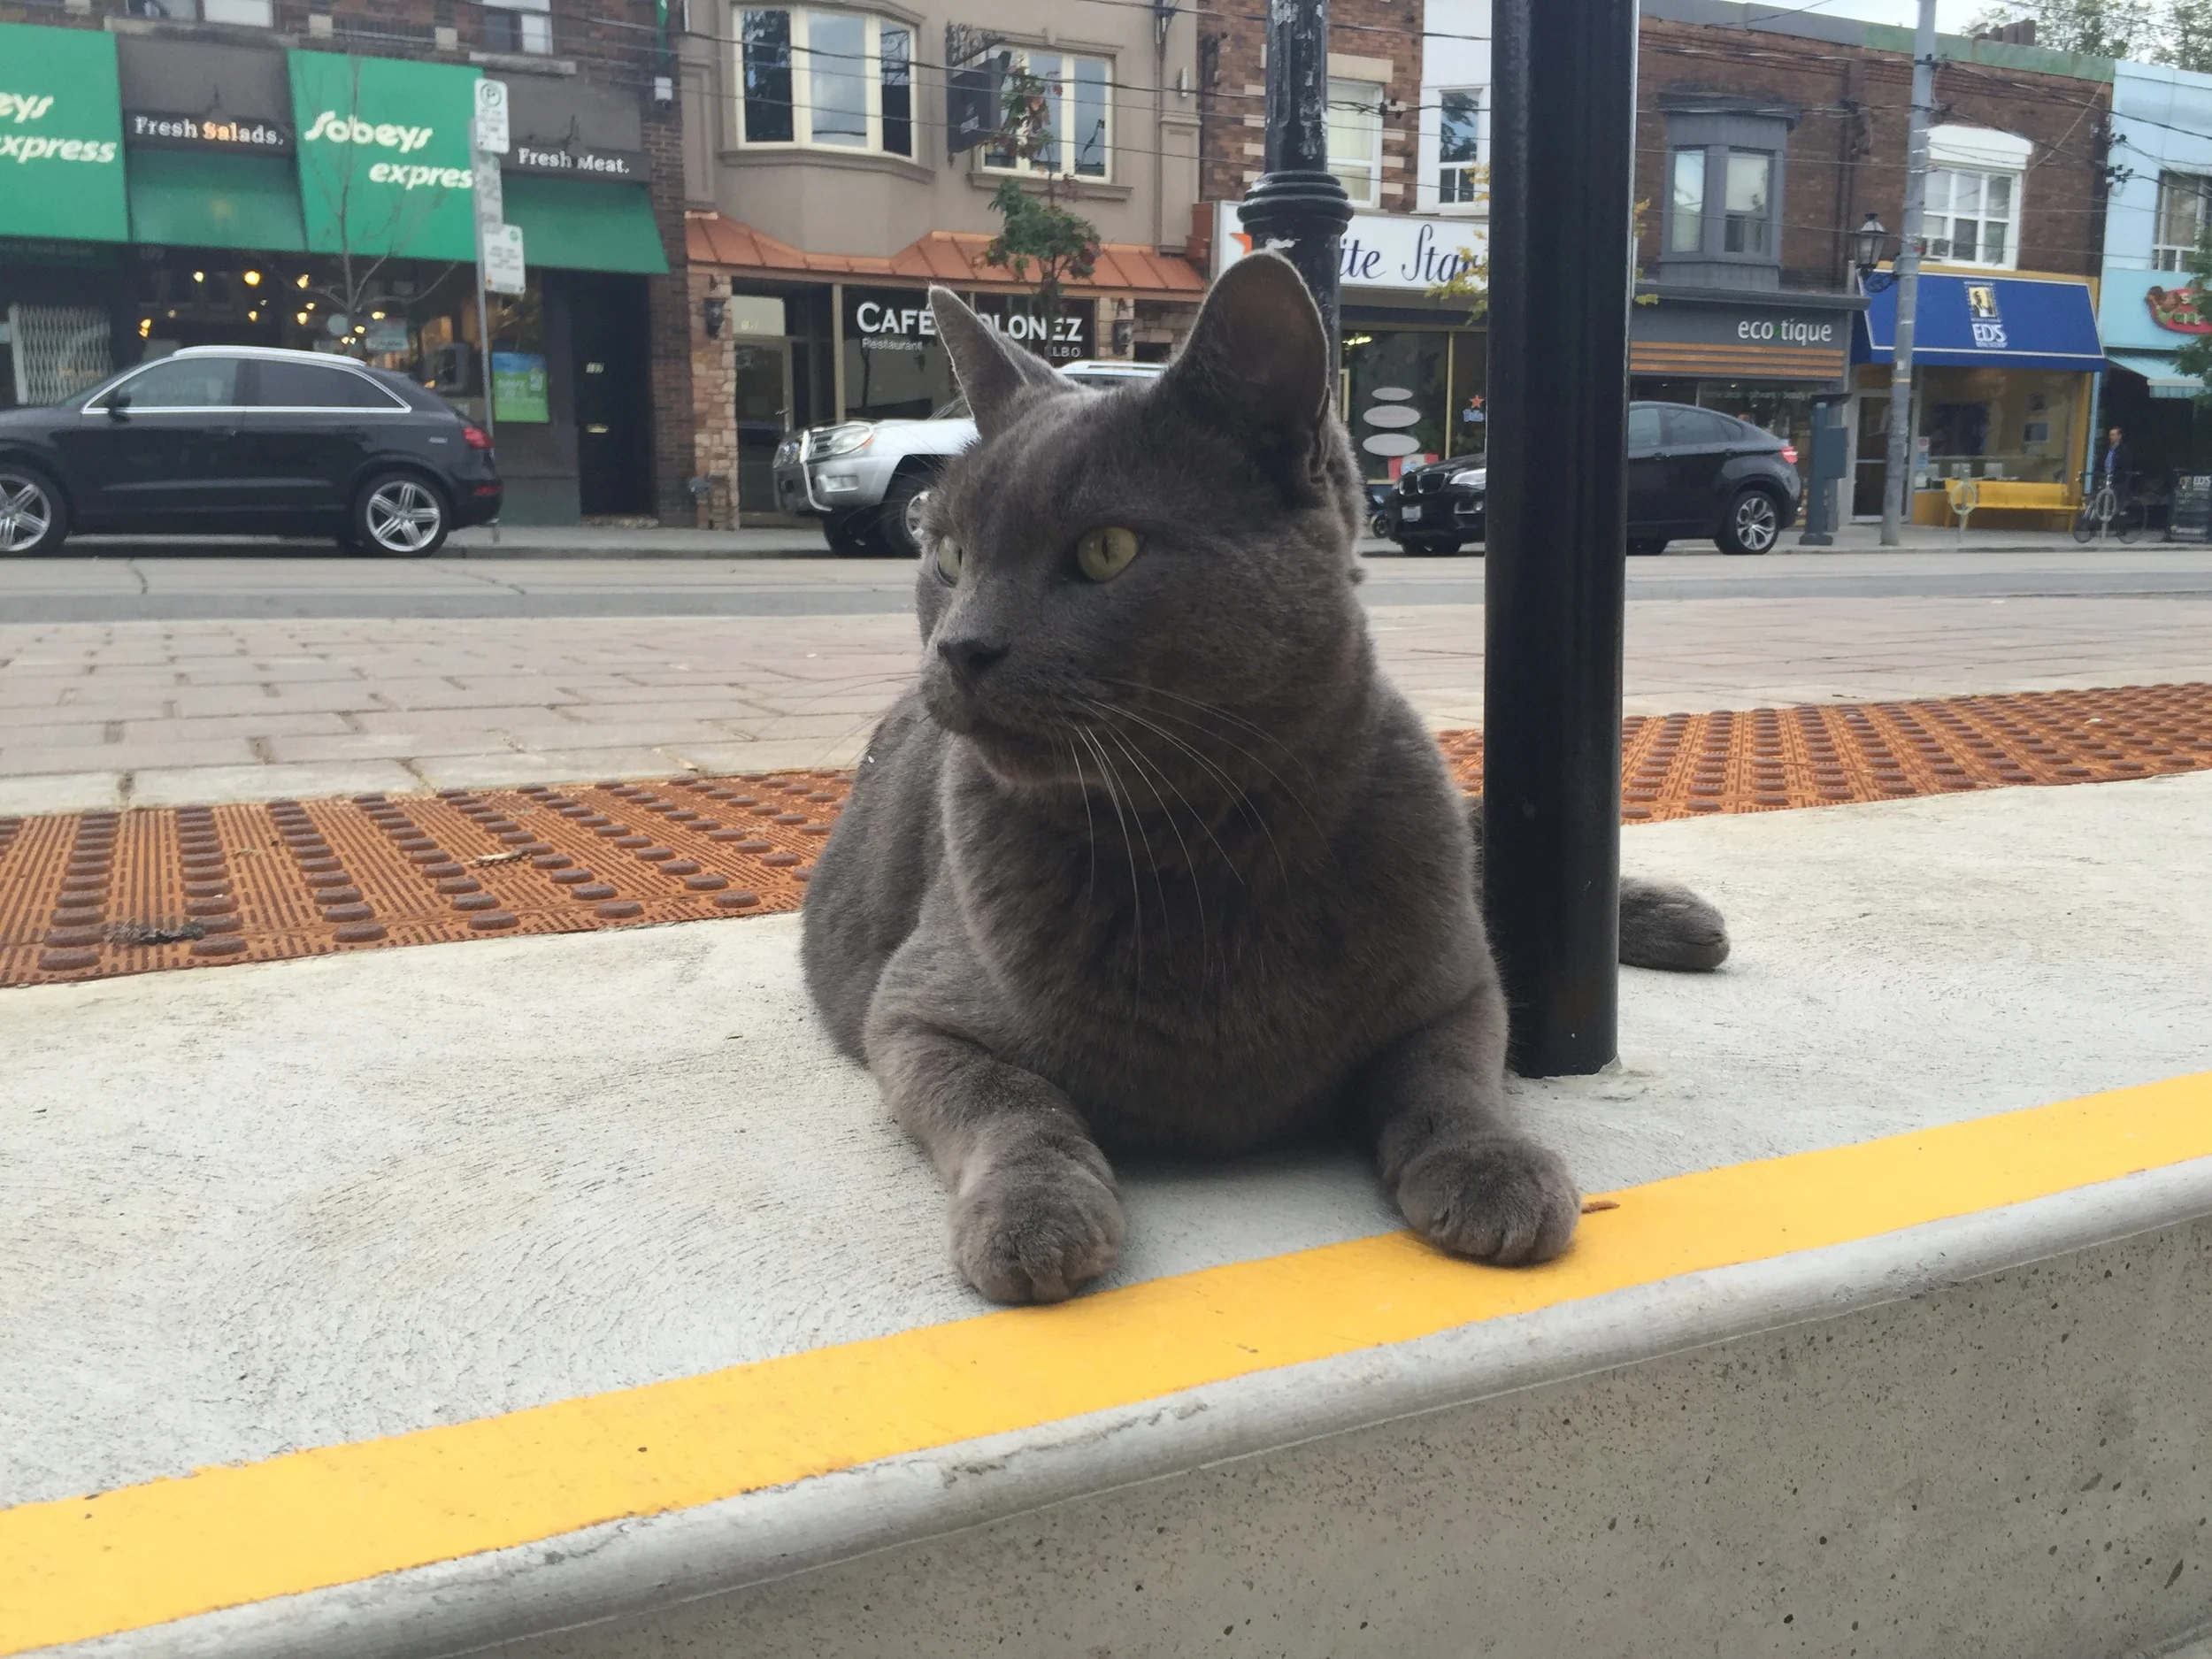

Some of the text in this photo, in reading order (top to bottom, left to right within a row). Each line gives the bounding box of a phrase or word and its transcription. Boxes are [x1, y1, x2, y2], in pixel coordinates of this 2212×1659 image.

[134, 116, 284, 145] Fresh Salads.
[303, 110, 434, 154] Sobeys
[0, 134, 117, 164] xpress
[518, 148, 630, 173] Fresh Meat.
[369, 163, 473, 190] expres
[1340, 238, 1386, 280] ite
[862, 337, 923, 351] Restaurant
